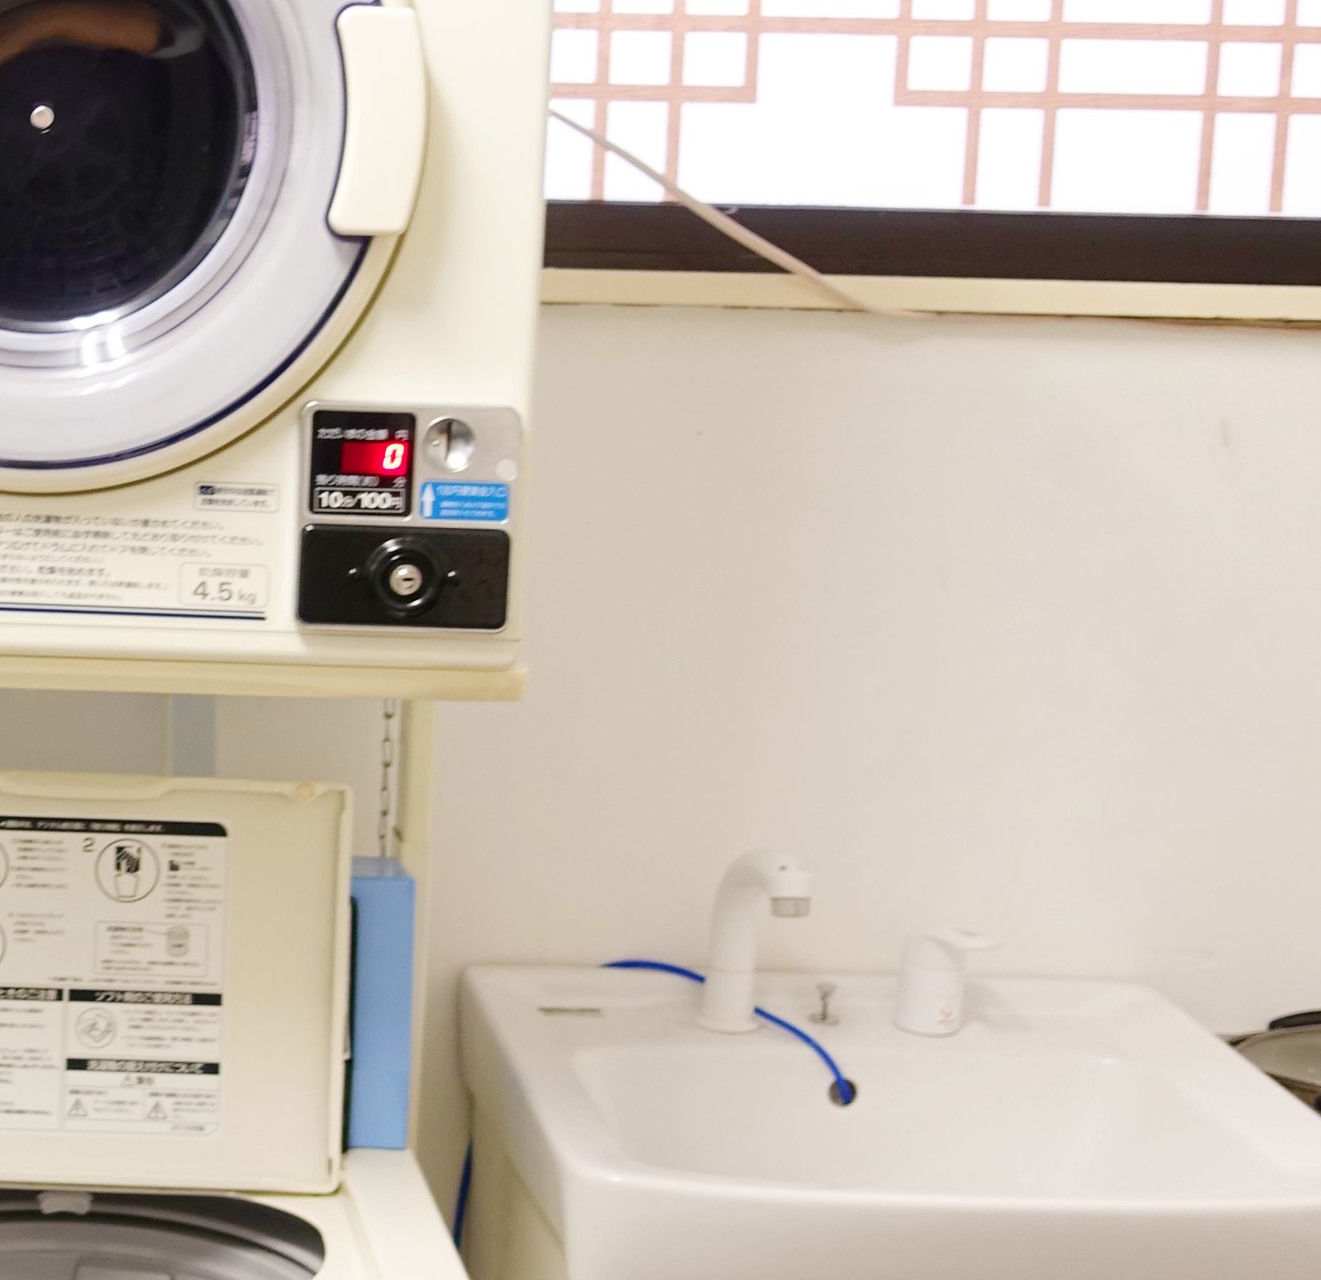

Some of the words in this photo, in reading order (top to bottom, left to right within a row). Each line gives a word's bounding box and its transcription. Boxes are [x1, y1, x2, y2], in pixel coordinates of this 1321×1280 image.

[383, 443, 405, 470] 0
[193, 580, 234, 602] 4.5
[82, 837, 96, 853] 2
